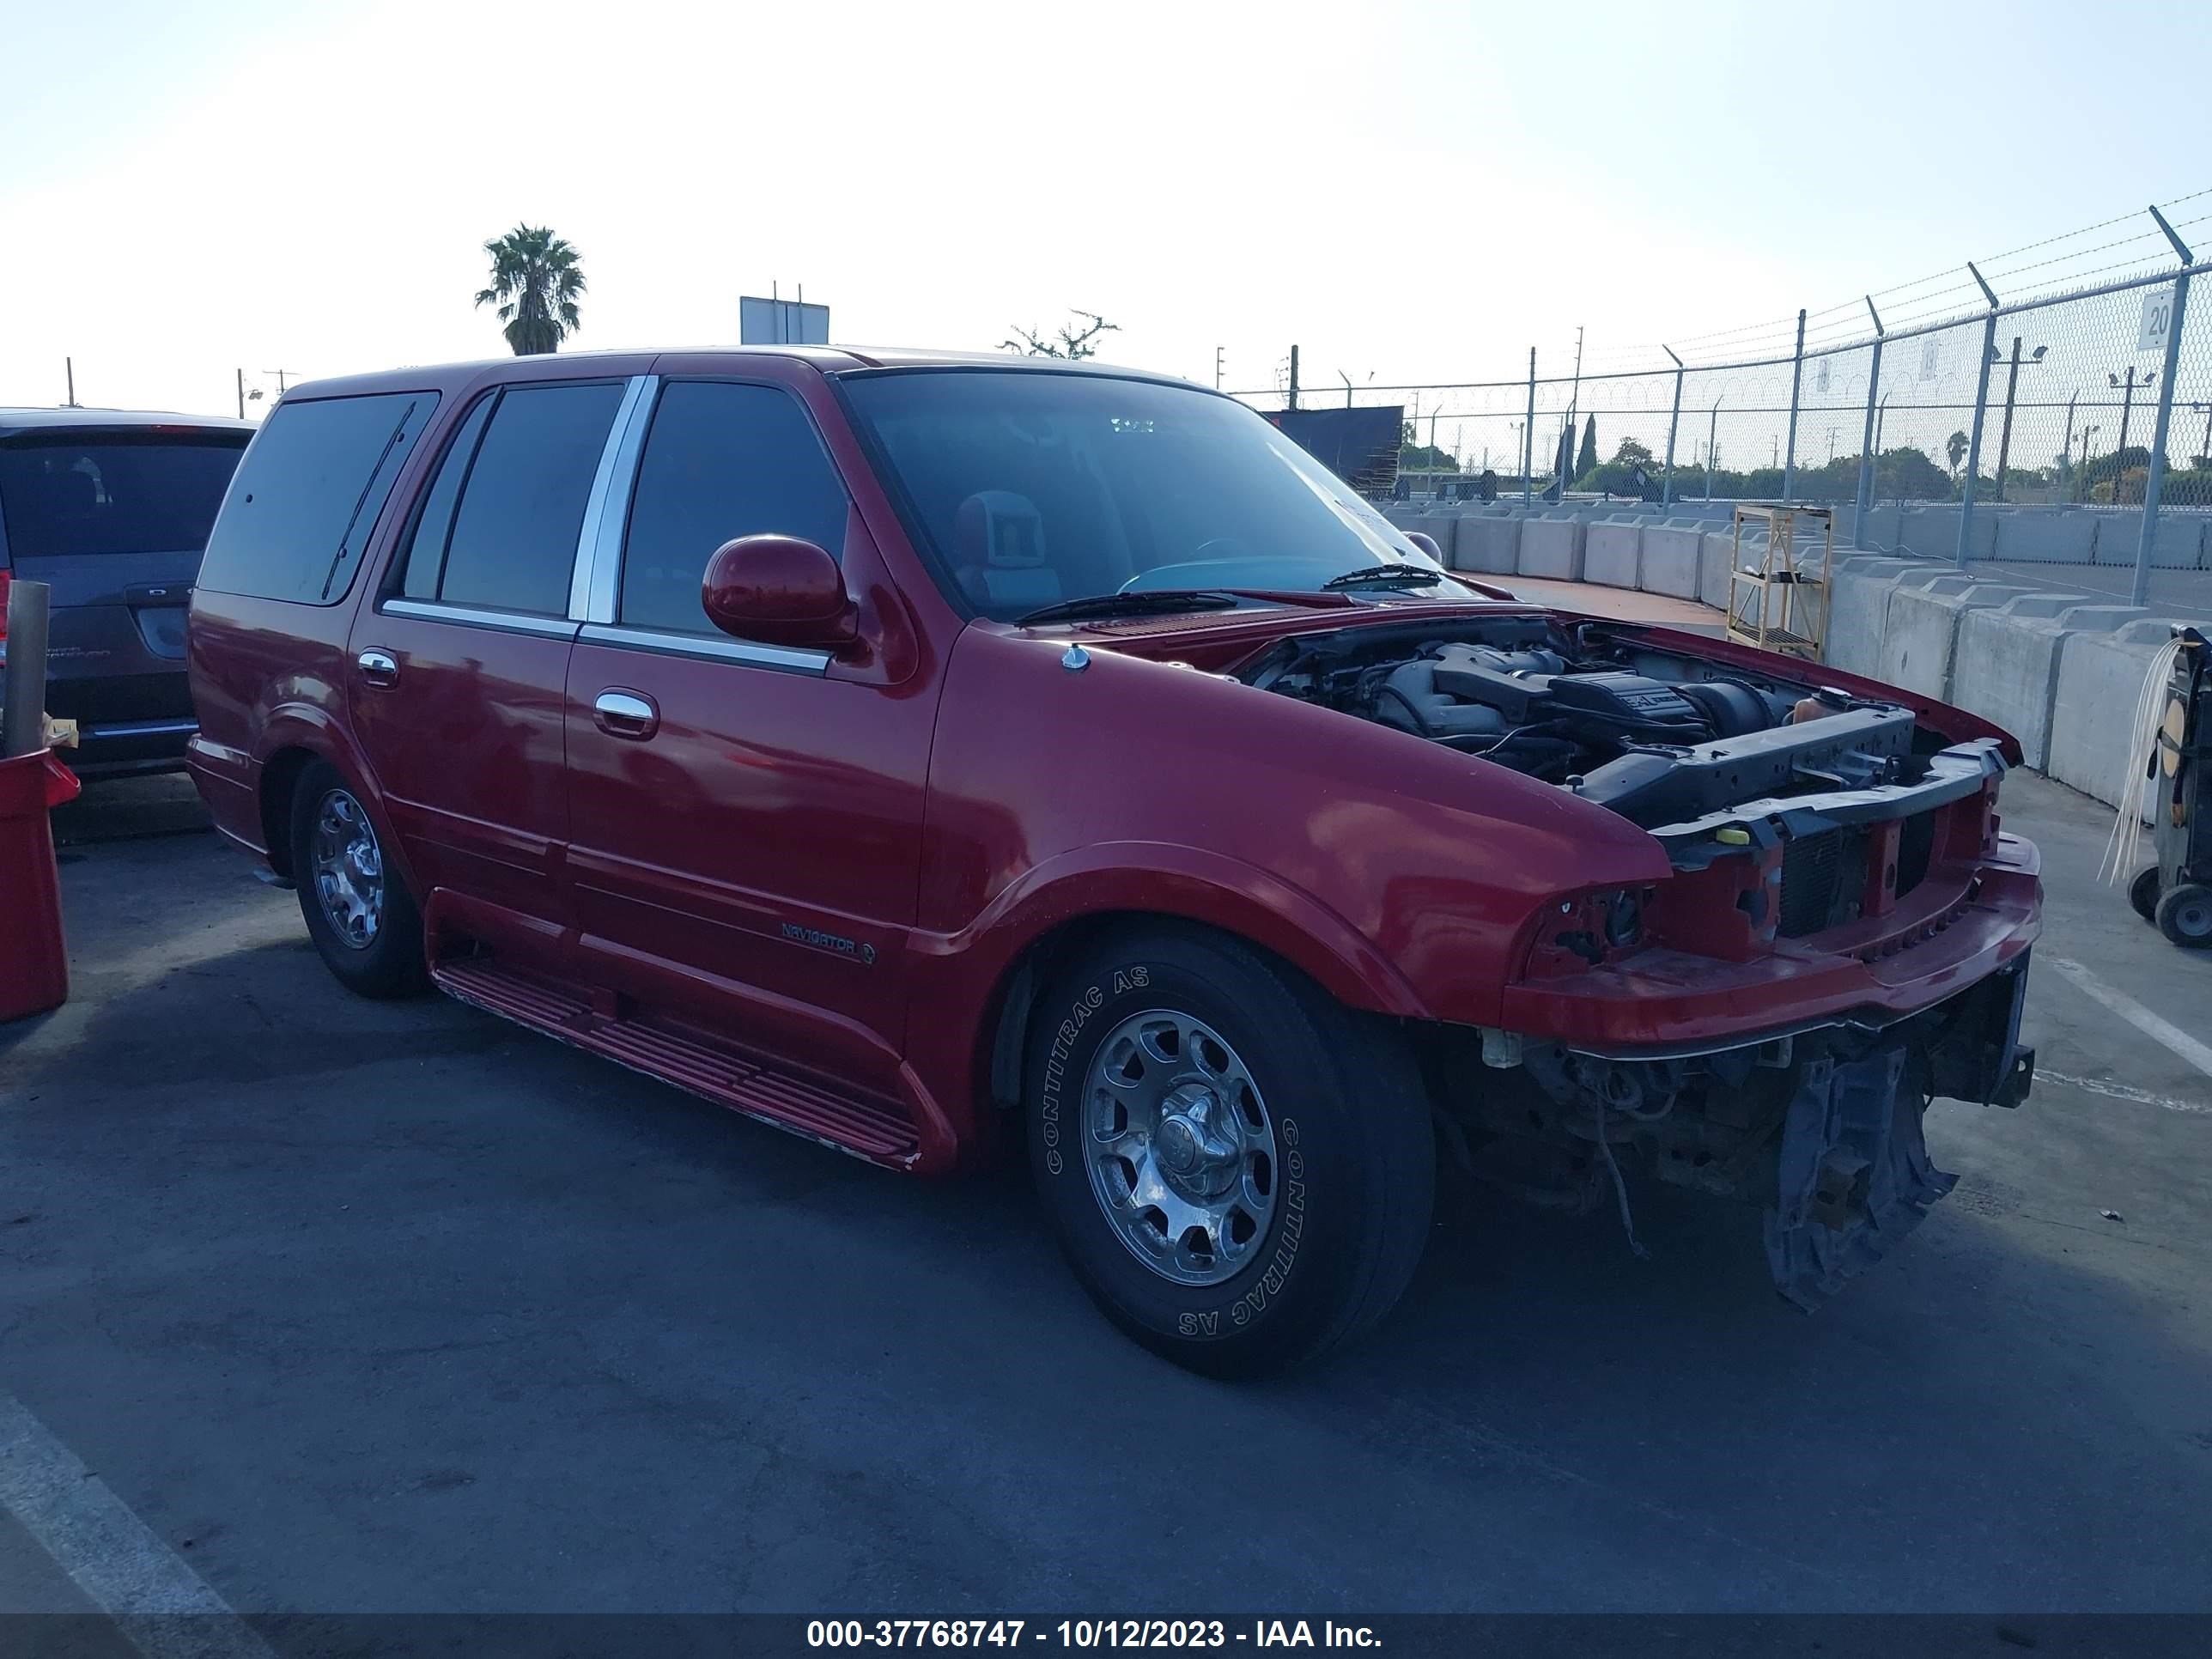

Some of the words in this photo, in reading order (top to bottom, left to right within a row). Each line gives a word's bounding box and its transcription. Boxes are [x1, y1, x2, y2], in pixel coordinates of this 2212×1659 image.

[2148, 305, 2169, 336] 20
[782, 923, 855, 953] NAVIGATOR
[1042, 987, 1103, 1175] CONTITRAC
[1114, 967, 1150, 994] AS
[1231, 1118, 1305, 1325] CONTITRAC
[1179, 1311, 1219, 1335] AS
